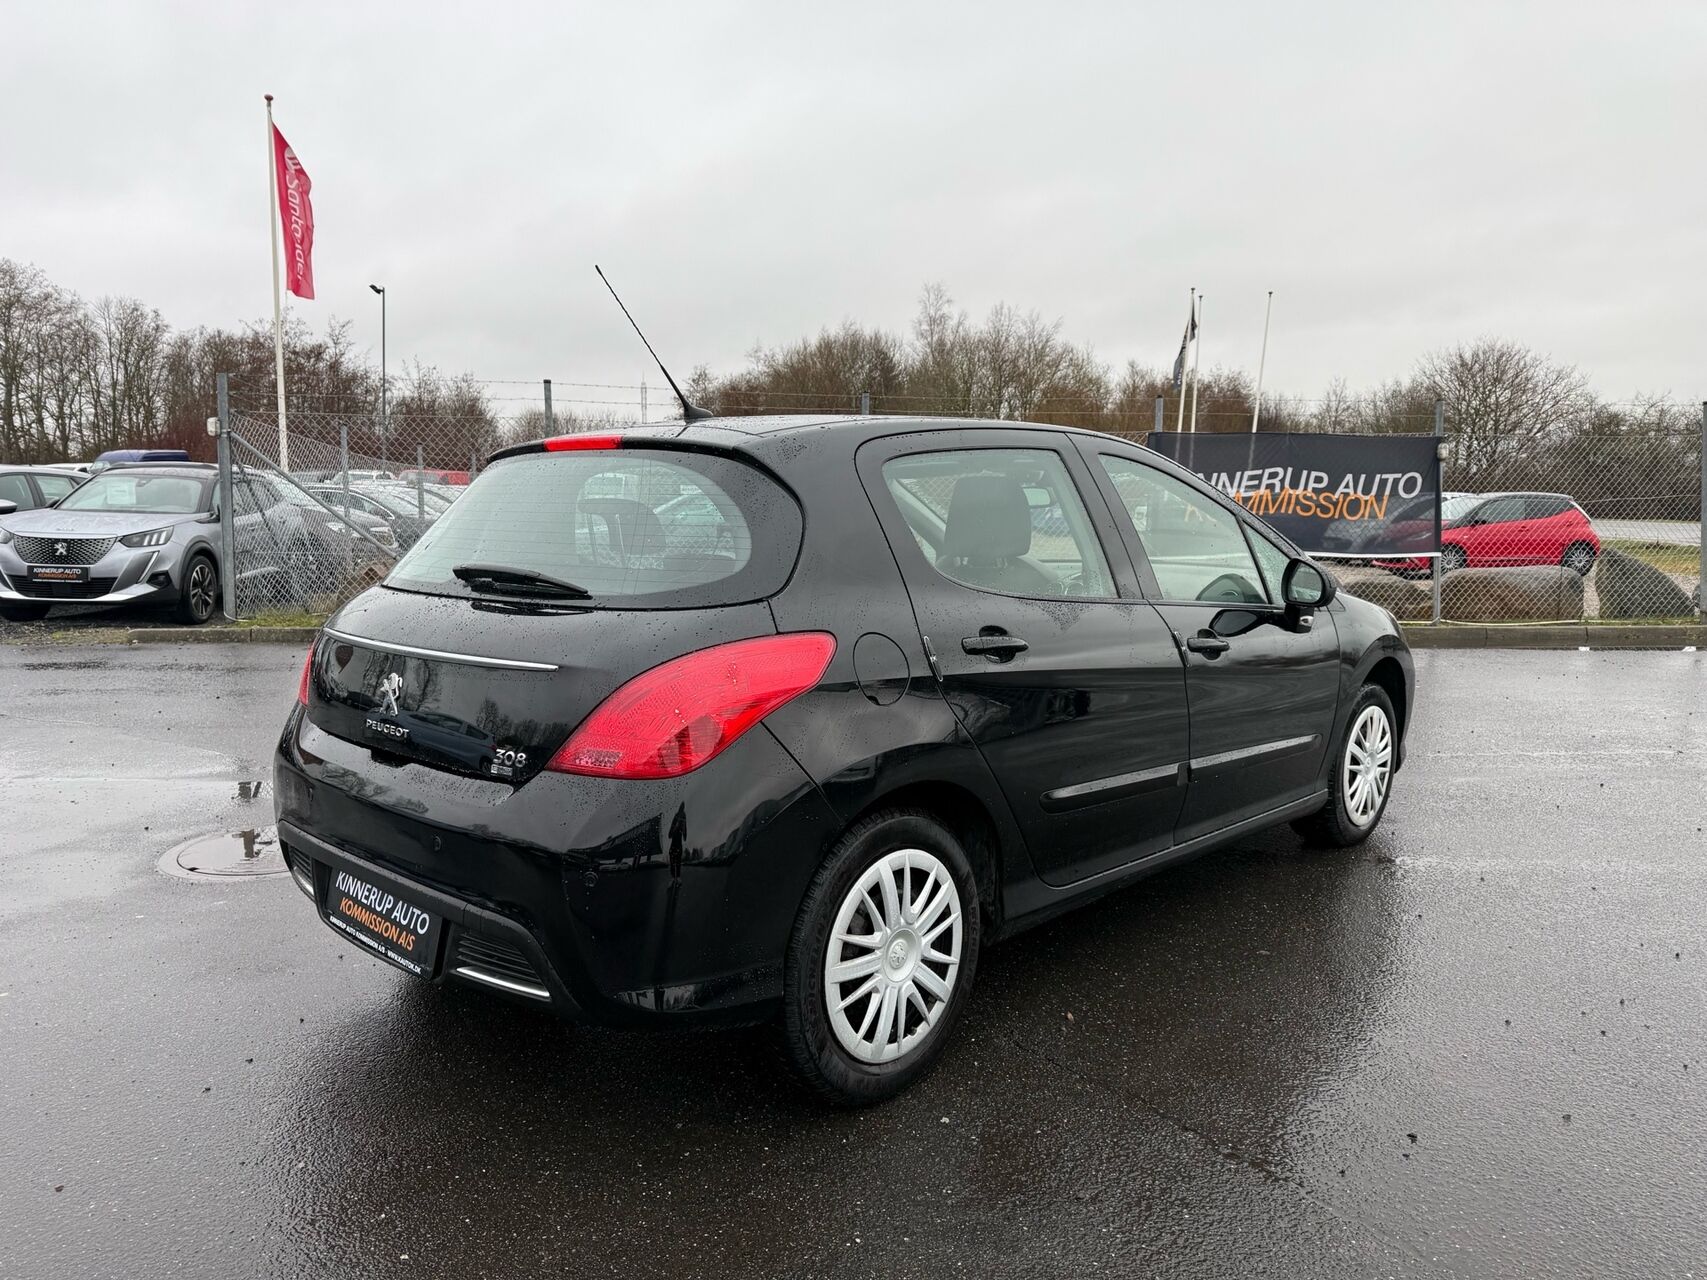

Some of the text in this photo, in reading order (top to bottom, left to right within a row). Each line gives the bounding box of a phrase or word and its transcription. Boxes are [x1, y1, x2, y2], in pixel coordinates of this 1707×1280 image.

[1335, 471, 1423, 499] AUTO
[1234, 486, 1389, 520] MMISSION
[366, 719, 410, 738] PEUGEOT
[493, 749, 526, 768] 308
[335, 871, 430, 935] KINNERUP AUTO
[340, 897, 400, 942] KOMMISSION
